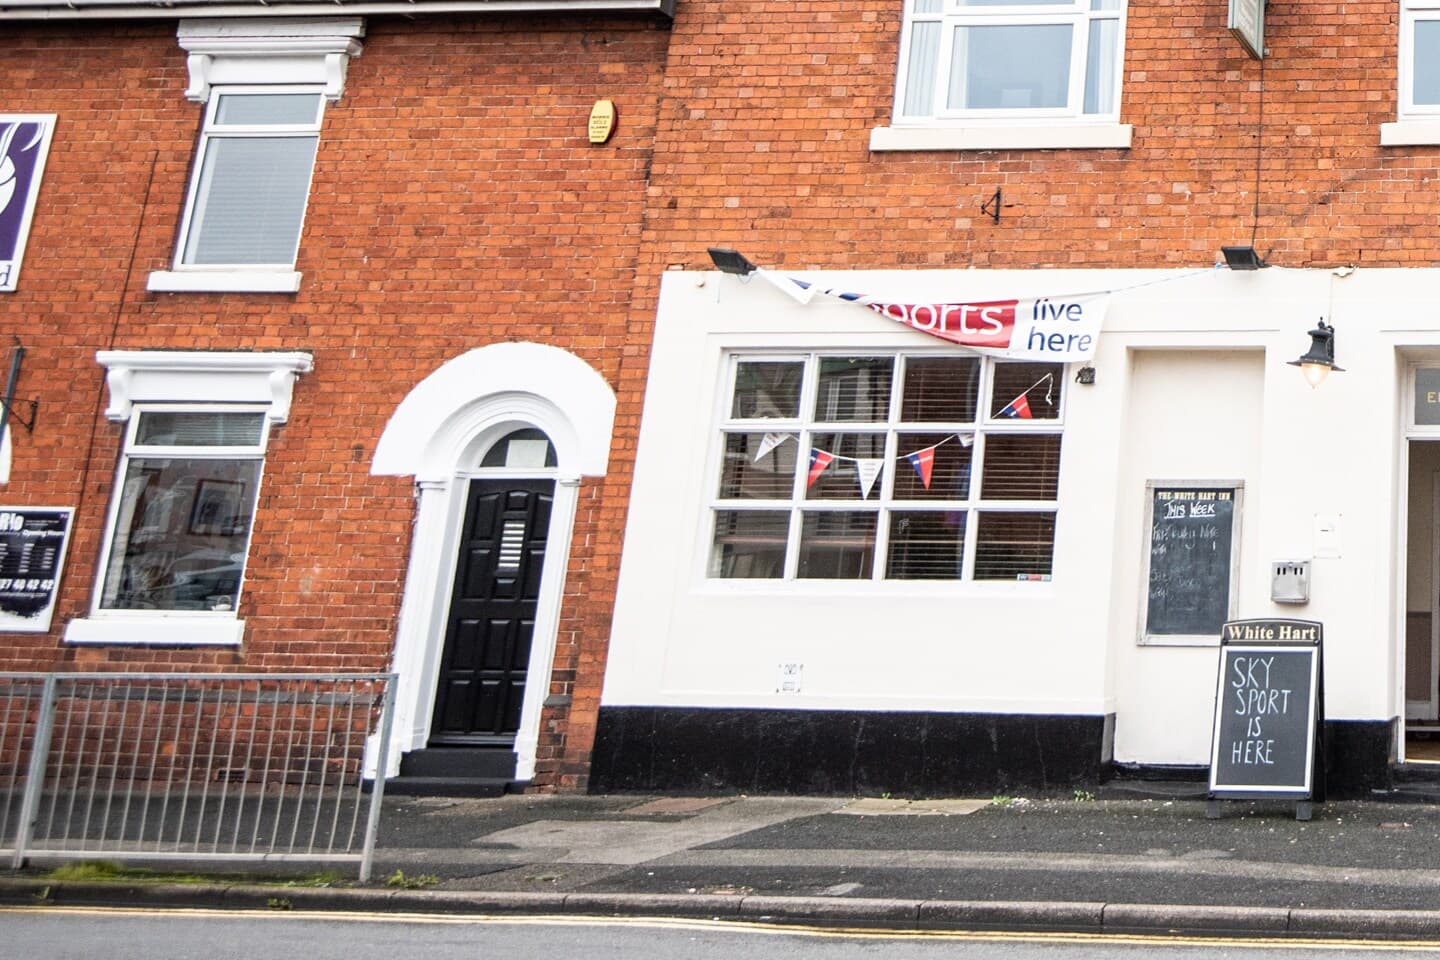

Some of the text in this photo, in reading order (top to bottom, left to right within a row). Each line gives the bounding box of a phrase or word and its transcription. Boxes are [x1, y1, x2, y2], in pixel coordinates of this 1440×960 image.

[872, 298, 1083, 336] ports live
[1027, 326, 1092, 353] here
[1228, 625, 1317, 640] White Hart
[1232, 656, 1274, 689] SKY
[1235, 688, 1292, 716] SPORT
[1247, 716, 1262, 737] IS
[1231, 739, 1275, 765] HERE
